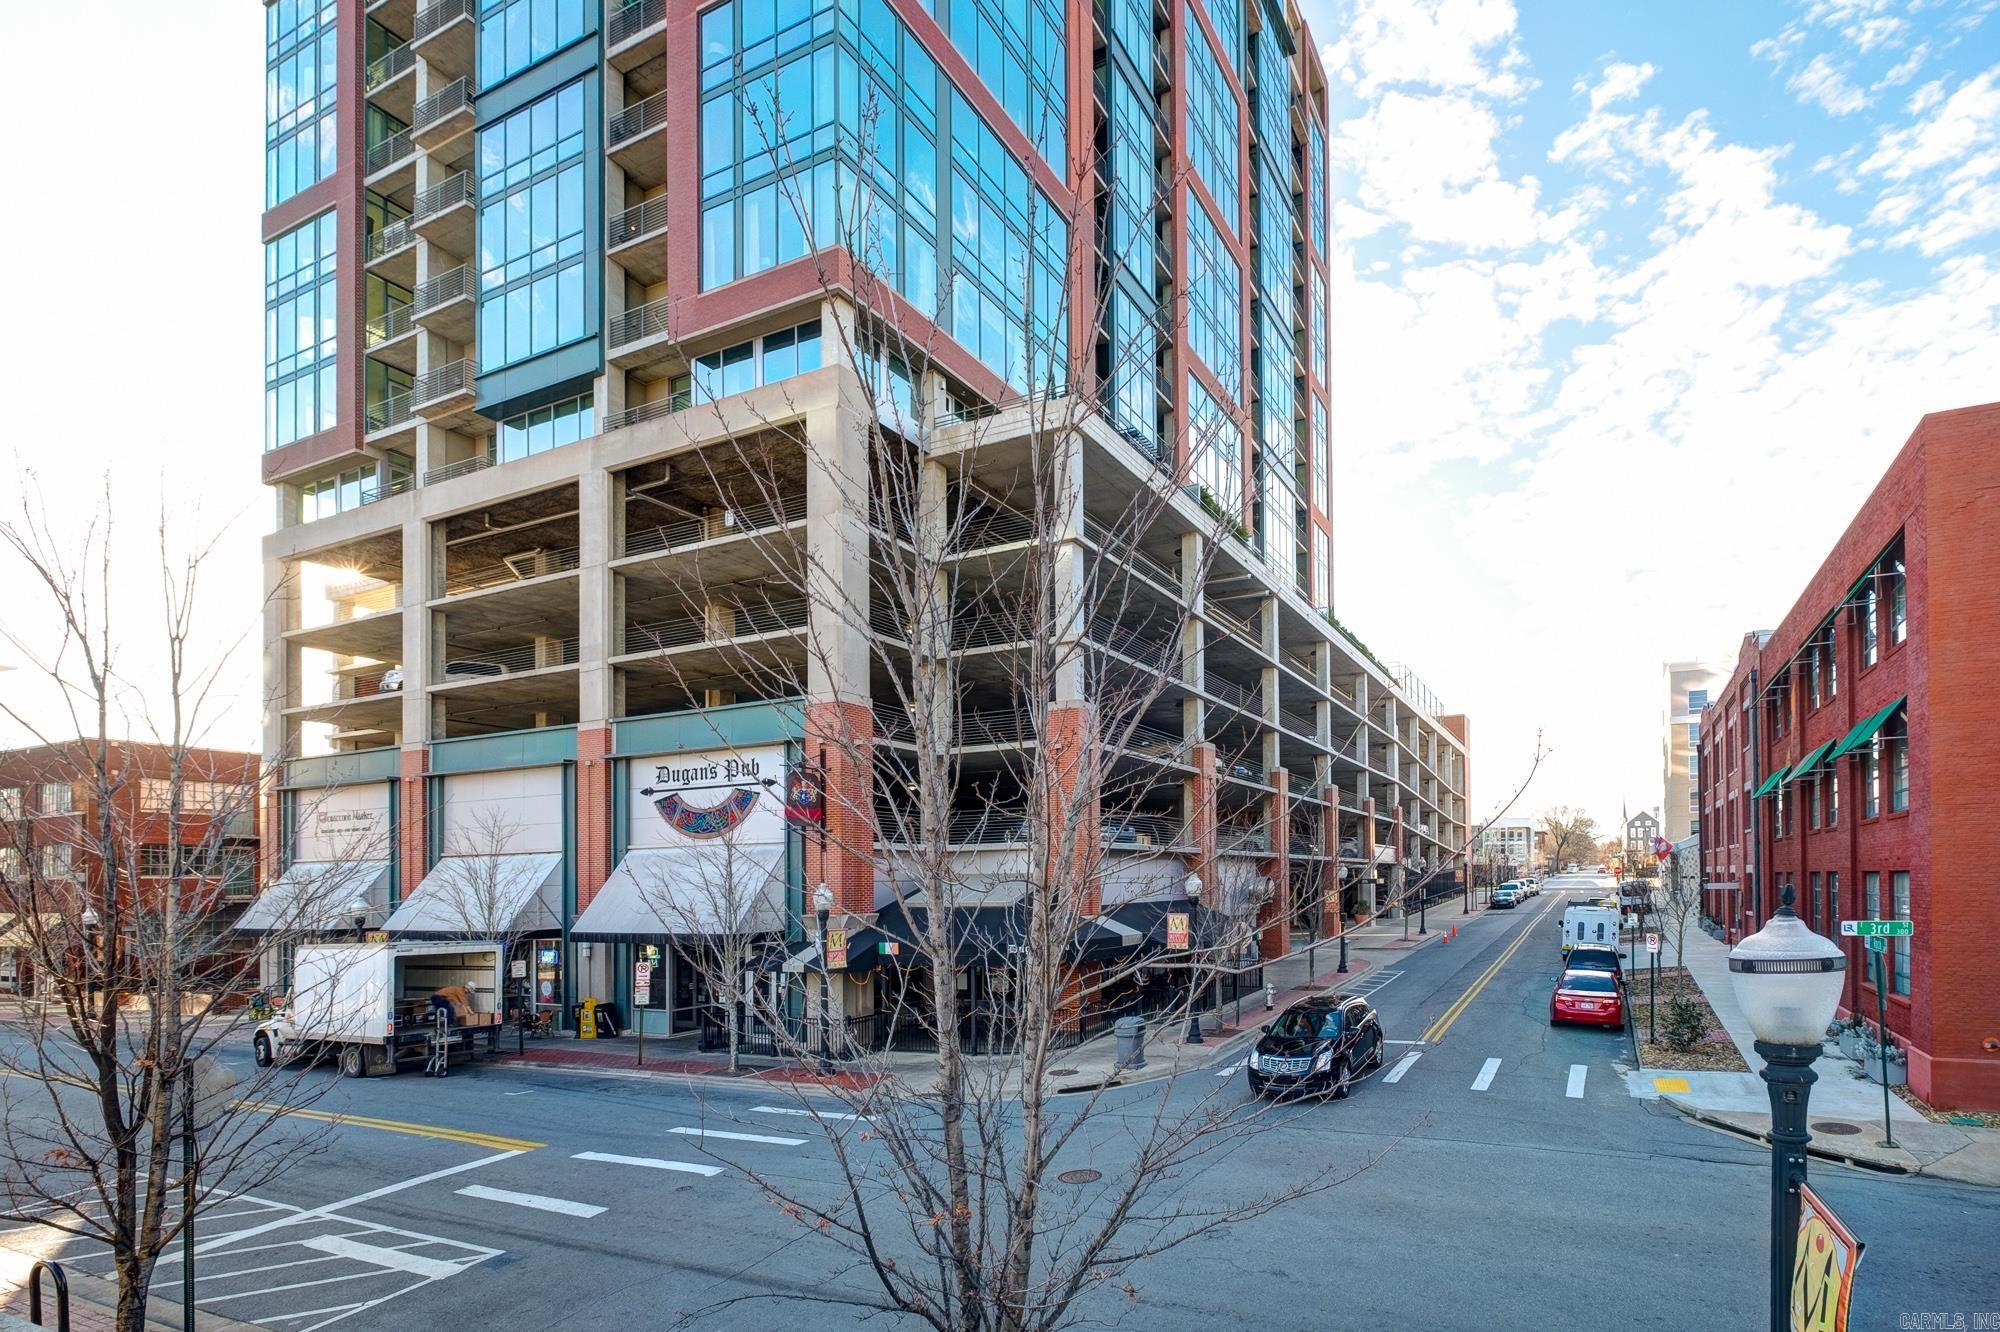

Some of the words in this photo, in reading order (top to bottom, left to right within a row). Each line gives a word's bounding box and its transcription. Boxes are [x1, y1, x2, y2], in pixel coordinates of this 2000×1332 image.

[656, 764, 718, 785] Dugan's
[724, 758, 760, 782] Pub
[1870, 922, 1890, 934] 3rd
